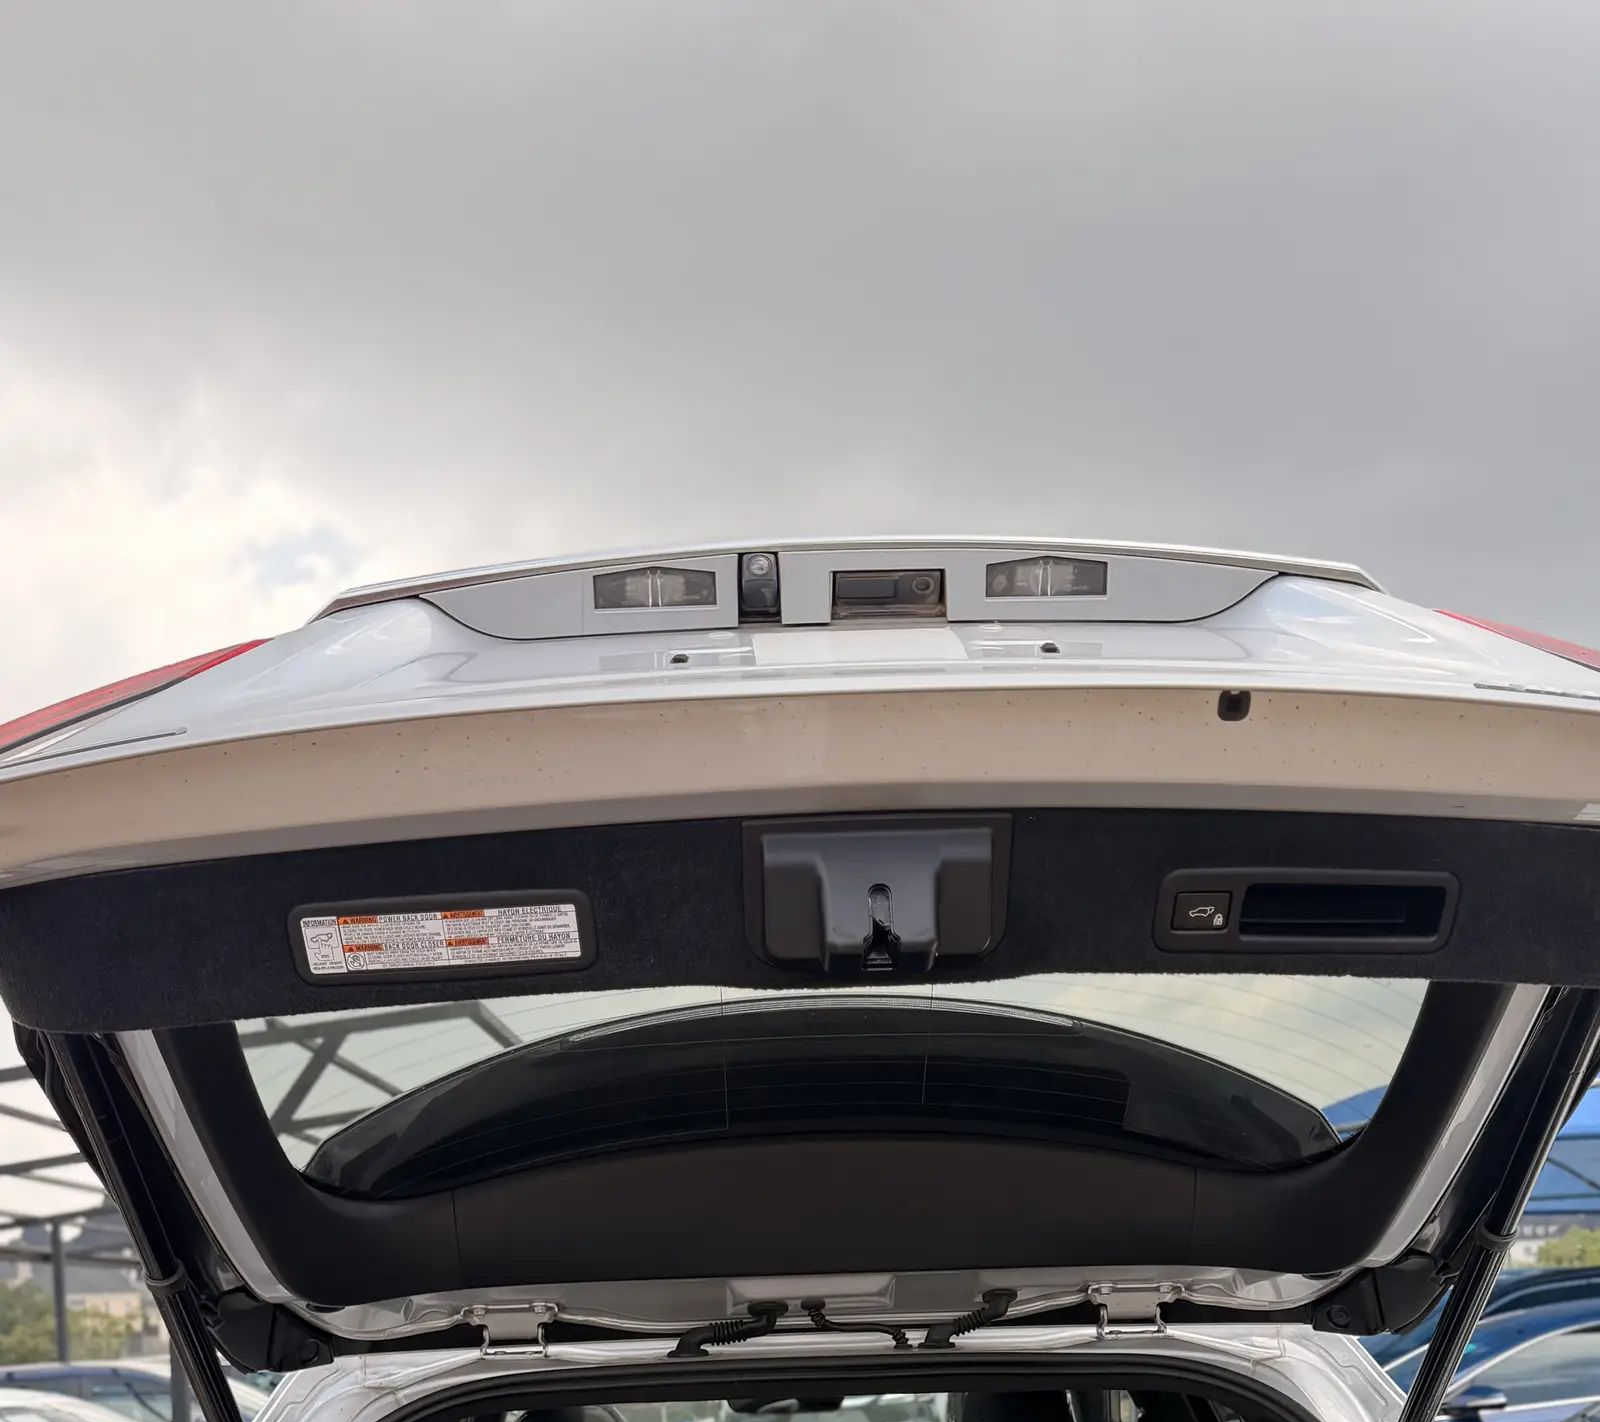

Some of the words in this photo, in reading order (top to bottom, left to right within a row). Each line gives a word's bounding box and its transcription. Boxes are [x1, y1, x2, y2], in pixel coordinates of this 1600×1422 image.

[303, 919, 337, 927] INFORMATION
[379, 915, 401, 923] POWER
[403, 914, 418, 922] BACK
[420, 913, 438, 921] DOOR
[384, 942, 399, 951] BACK
[401, 941, 419, 950] DOOR
[421, 940, 444, 949] CLOSER
